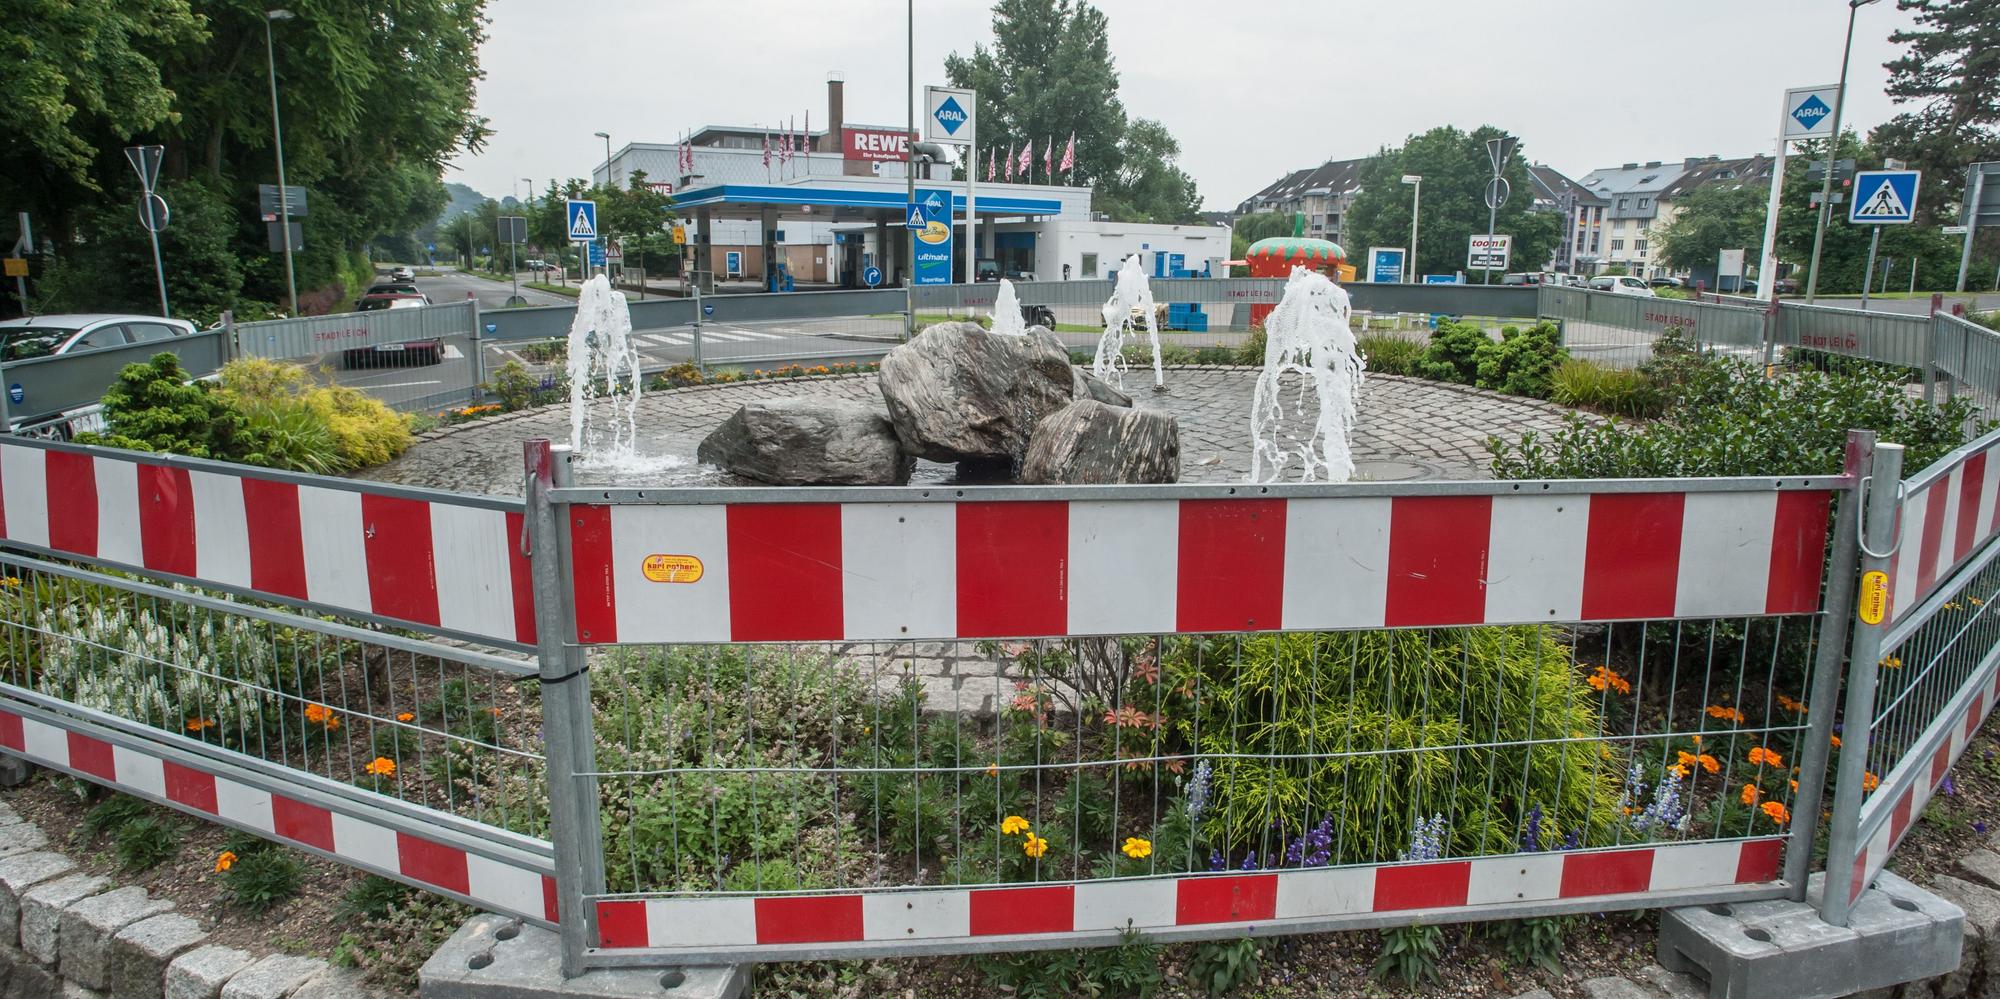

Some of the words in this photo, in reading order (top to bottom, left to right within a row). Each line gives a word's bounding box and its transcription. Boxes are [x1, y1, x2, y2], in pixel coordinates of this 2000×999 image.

[938, 110, 964, 121] ARAL
[1796, 107, 1825, 118] ARAL
[855, 133, 909, 152] REWE
[917, 253, 949, 261] ultimate
